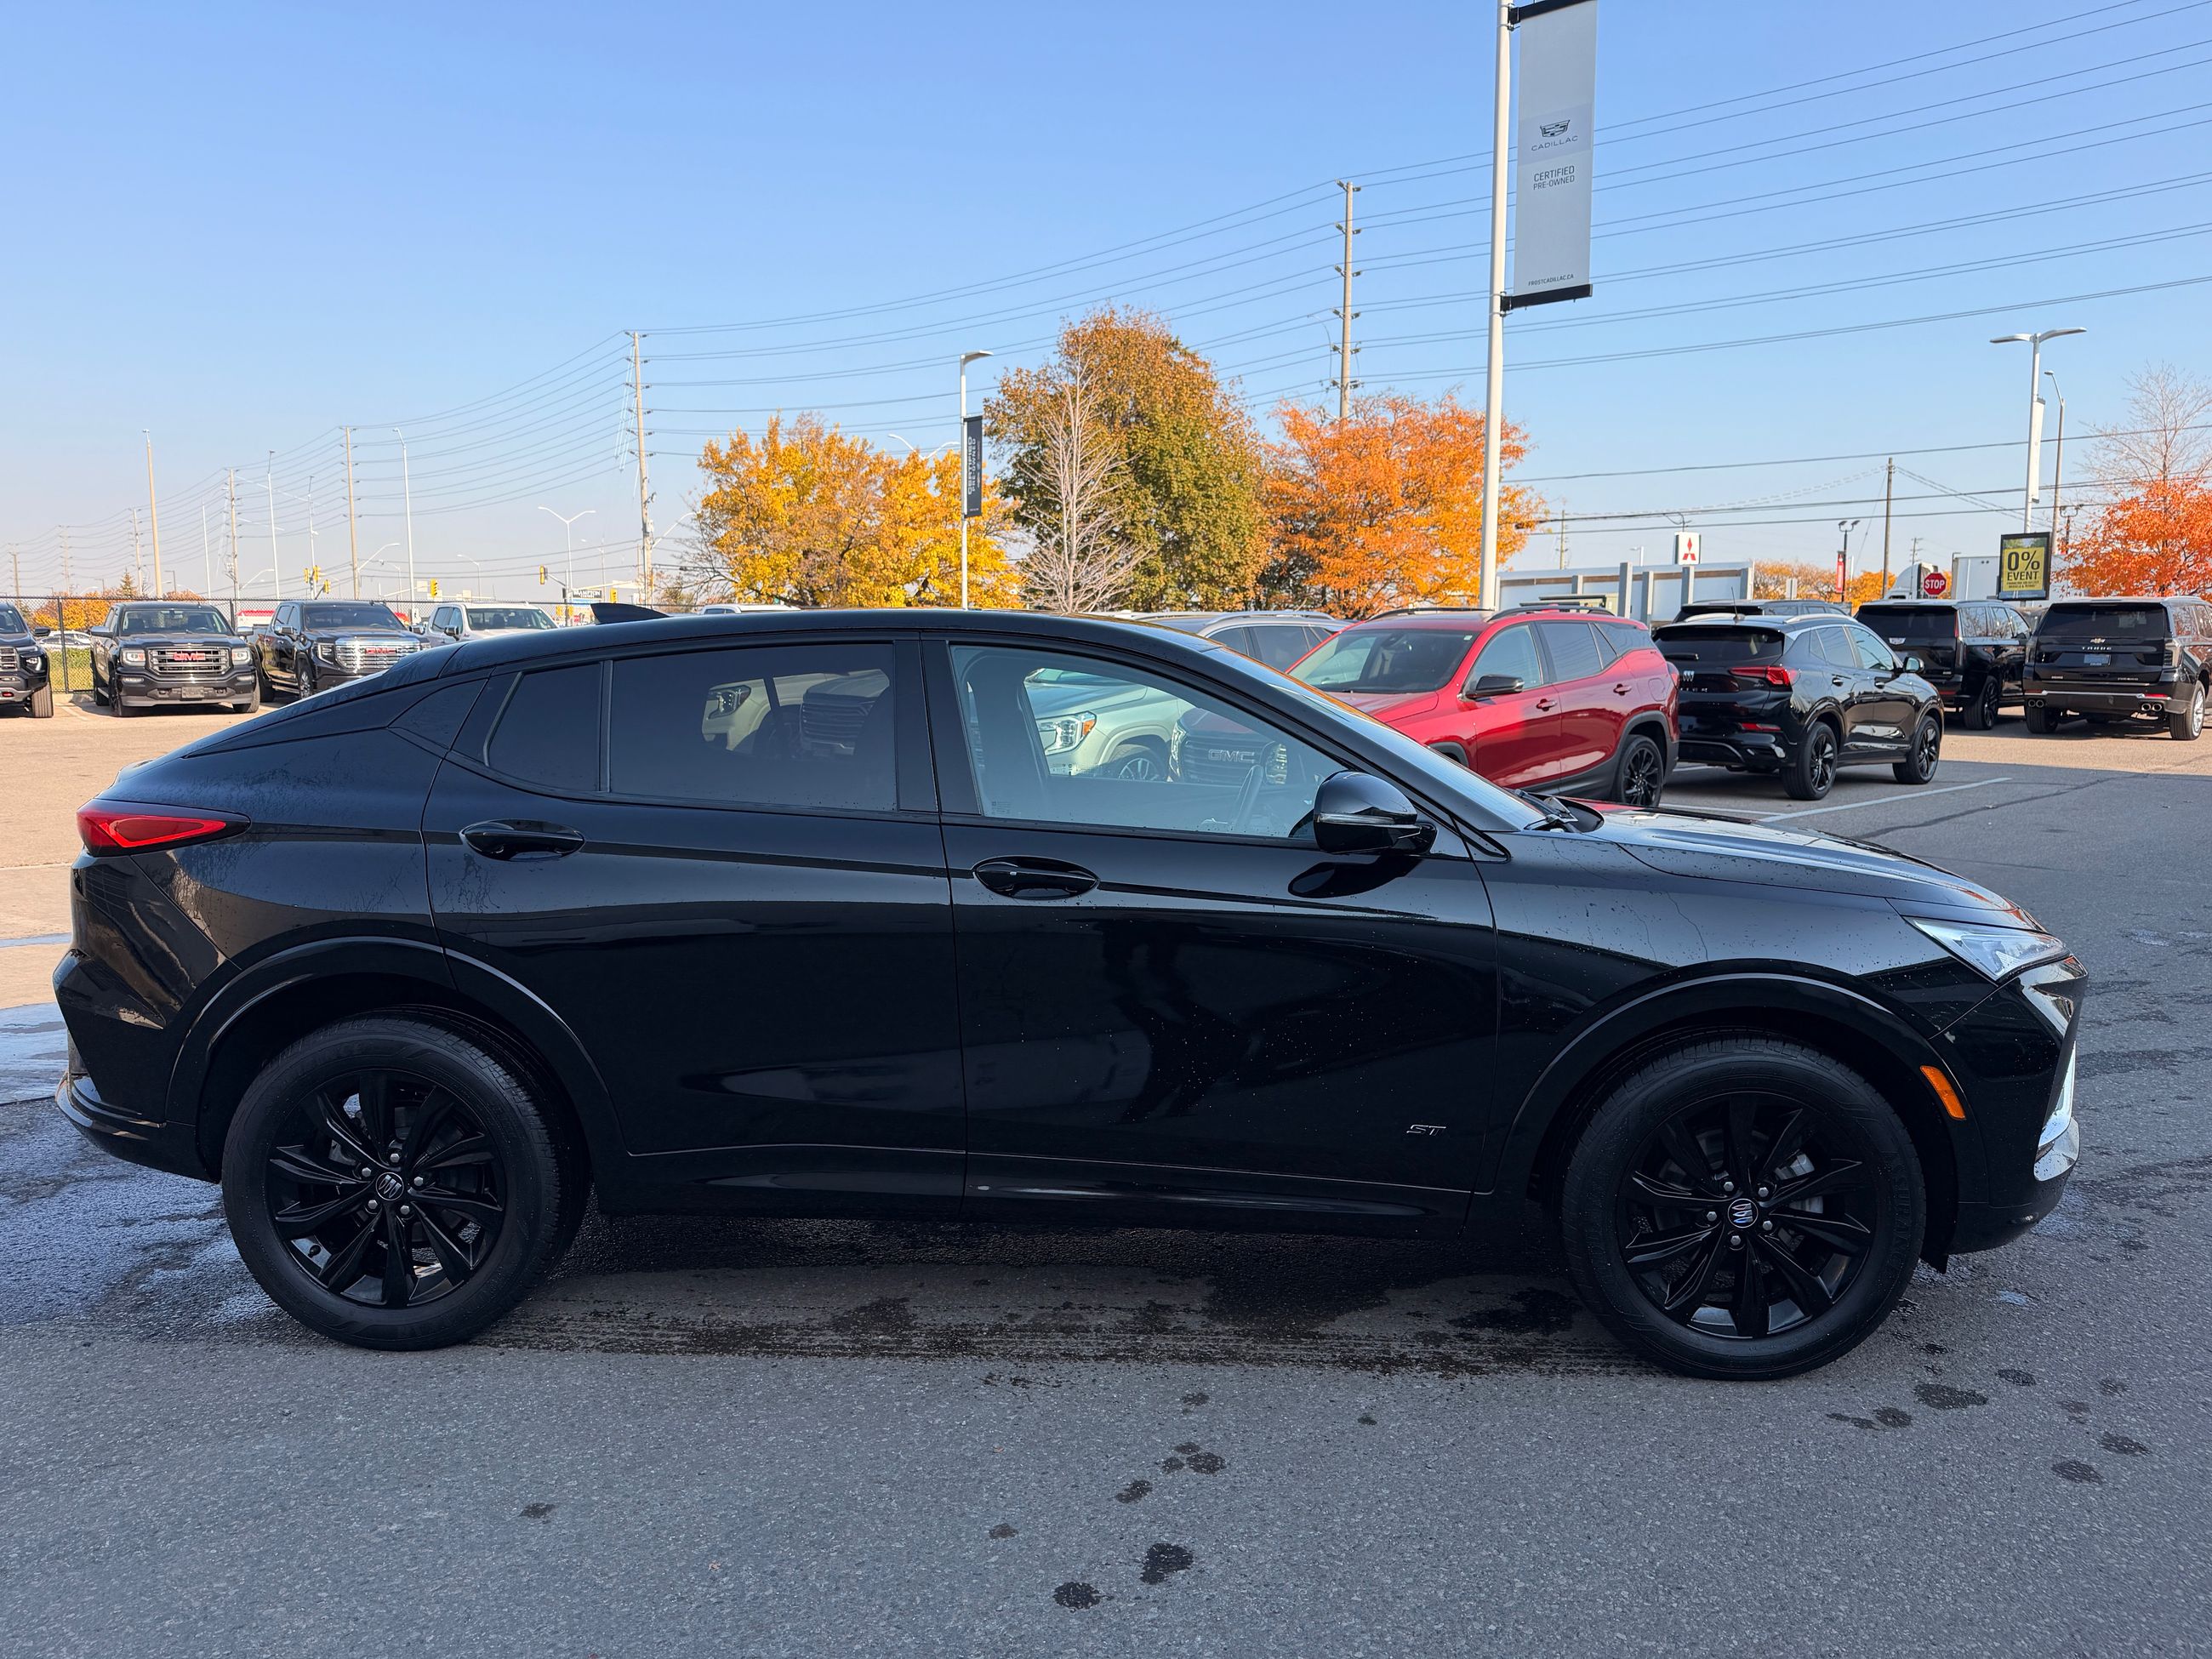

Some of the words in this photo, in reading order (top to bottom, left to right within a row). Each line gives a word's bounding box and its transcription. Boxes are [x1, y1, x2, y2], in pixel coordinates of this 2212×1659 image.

[1531, 135, 1578, 151] CADILLAC
[1533, 165, 1575, 182] CERTIFIED
[1533, 174, 1575, 191] PRE-OWNED
[2008, 550, 2040, 571] 0%
[2007, 571, 2039, 581] EVENT
[1924, 579, 1945, 589] STOP
[173, 653, 206, 661] GMC
[365, 647, 396, 656] GMC
[1208, 749, 1255, 763] GMC
[1406, 1124, 1447, 1136] ST
